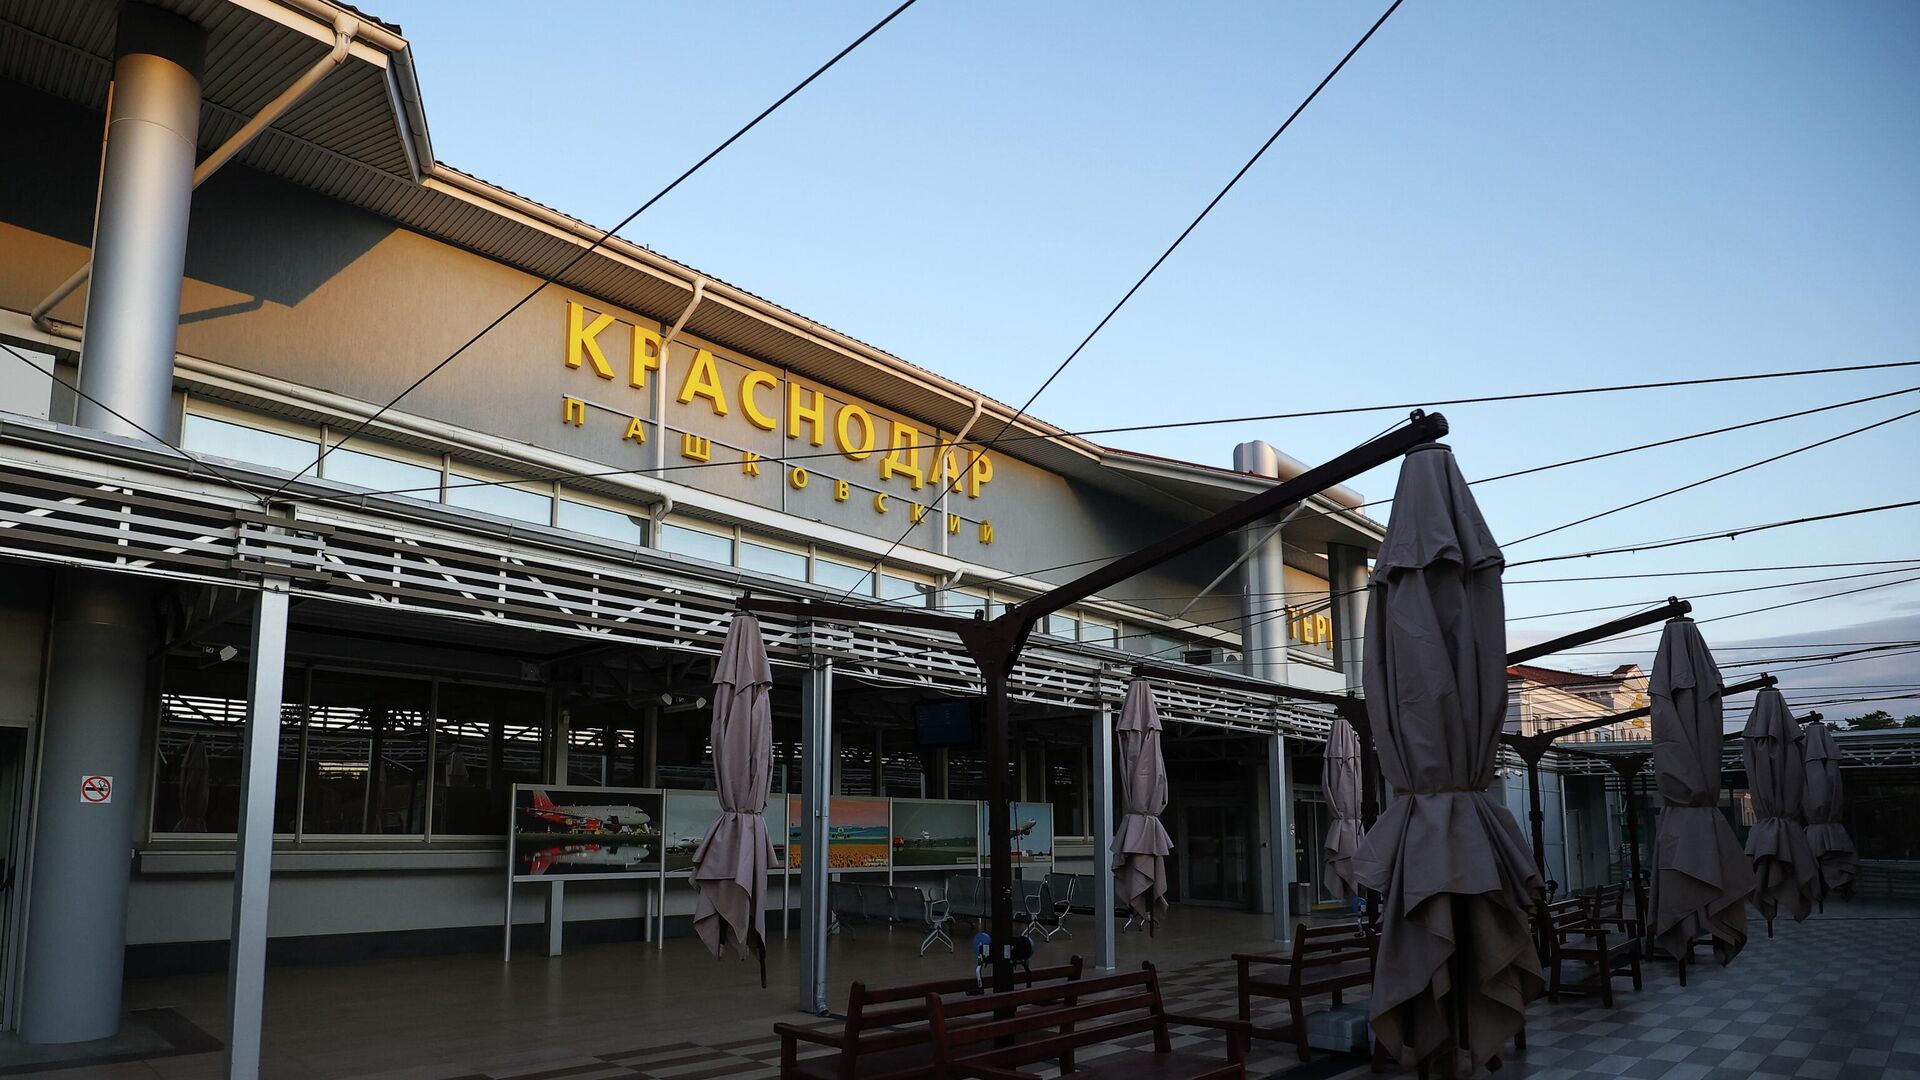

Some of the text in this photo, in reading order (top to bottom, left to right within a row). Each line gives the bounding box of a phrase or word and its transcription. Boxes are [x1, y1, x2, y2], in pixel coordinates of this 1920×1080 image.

[563, 399, 993, 545] ПАШКОВСКИЙ
[565, 301, 994, 498] КРАСНОДАР
[1288, 607, 1333, 650] ТЕР
